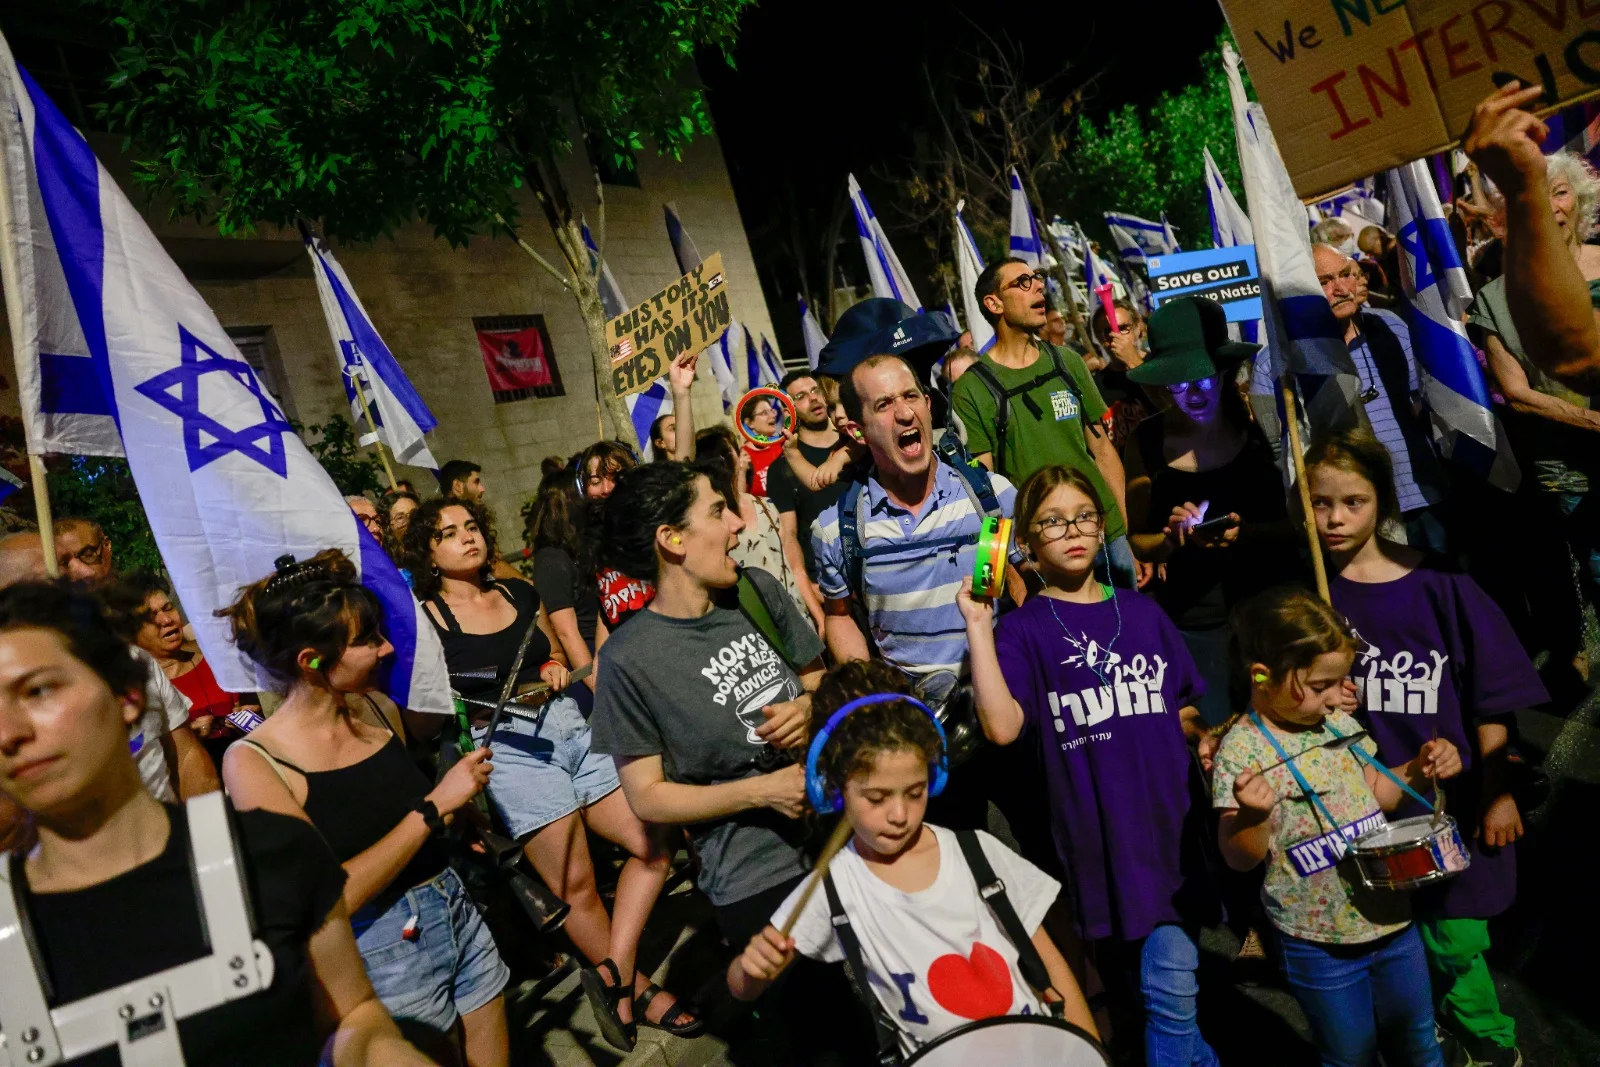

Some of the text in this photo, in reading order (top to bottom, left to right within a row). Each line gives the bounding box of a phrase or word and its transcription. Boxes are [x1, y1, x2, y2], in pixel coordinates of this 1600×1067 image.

[1254, 19, 1322, 64] We
[1157, 264, 1240, 290] Save our
[1220, 284, 1261, 300] Natio
[614, 263, 704, 338] HISTORY
[634, 283, 709, 350] HAS ITS
[612, 290, 730, 396] EYES ON YOU
[713, 661, 748, 706] DON'T
[733, 662, 780, 702] ADVICE
[1090, 731, 1112, 742] עתיד
